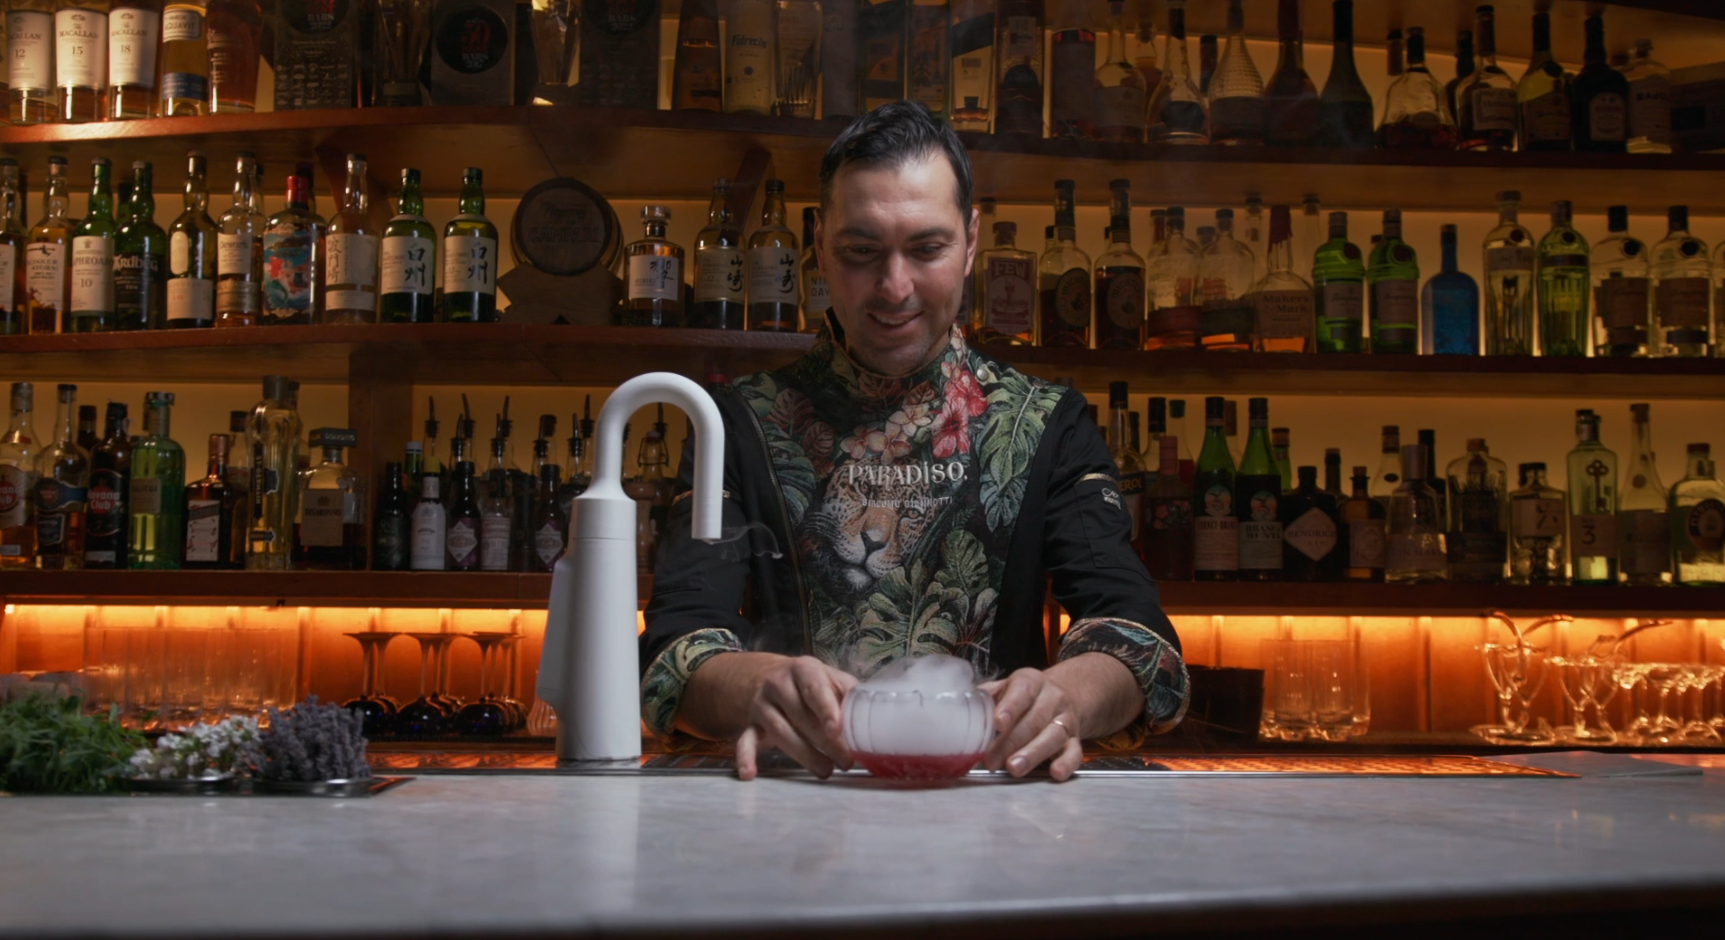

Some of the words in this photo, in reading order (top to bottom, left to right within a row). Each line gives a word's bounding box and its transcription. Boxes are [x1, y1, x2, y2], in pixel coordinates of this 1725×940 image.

[15, 49, 26, 57] 12
[72, 46, 84, 55] 15
[121, 45, 131, 53] 18
[994, 261, 1028, 277] FEW
[80, 278, 92, 287] 10
[811, 288, 830, 297] DAY
[1276, 304, 1309, 313] Mark
[1118, 477, 1143, 491] EROL
[90, 499, 111, 510] Club
[305, 508, 342, 516] DISARONNO
[1581, 526, 1596, 545] 3
